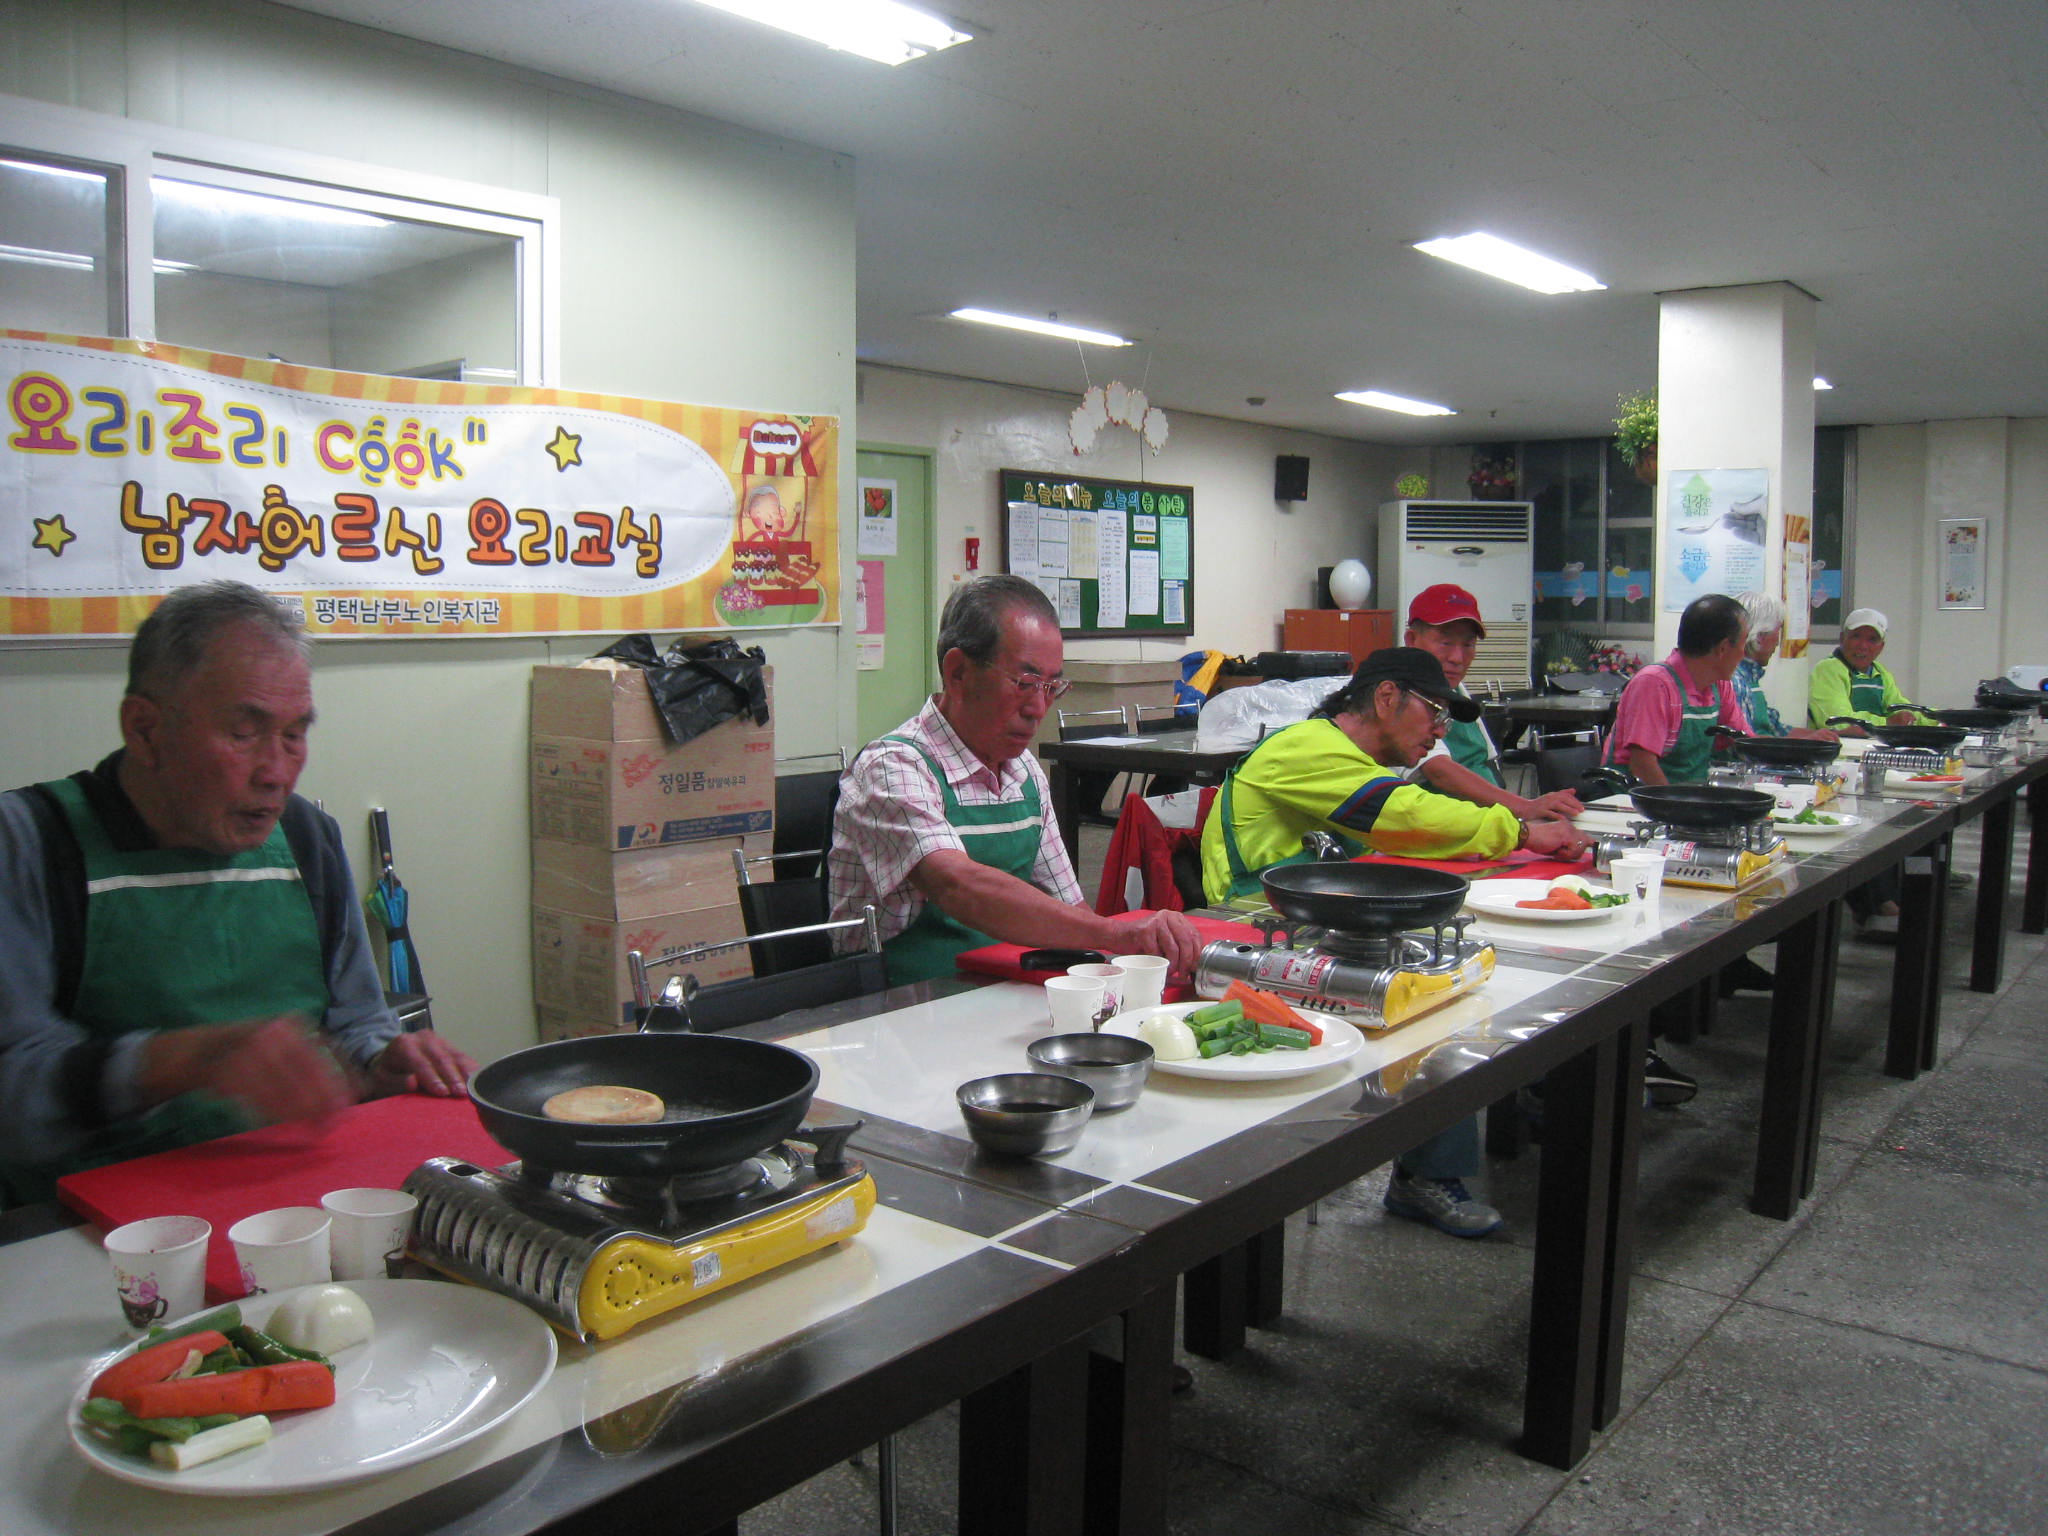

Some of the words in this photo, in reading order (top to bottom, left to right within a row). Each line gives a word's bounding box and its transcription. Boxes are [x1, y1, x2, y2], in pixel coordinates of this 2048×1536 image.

[9, 373, 288, 466] 요리조리
[753, 430, 797, 446] Bakery
[1023, 482, 1066, 508] 오늘의
[1103, 489, 1140, 513] 오늘의
[120, 480, 445, 576] 남자어르신
[466, 497, 663, 579] 요리교실
[315, 598, 500, 624] 평택남부노인복지관
[657, 771, 705, 795] 정일품
